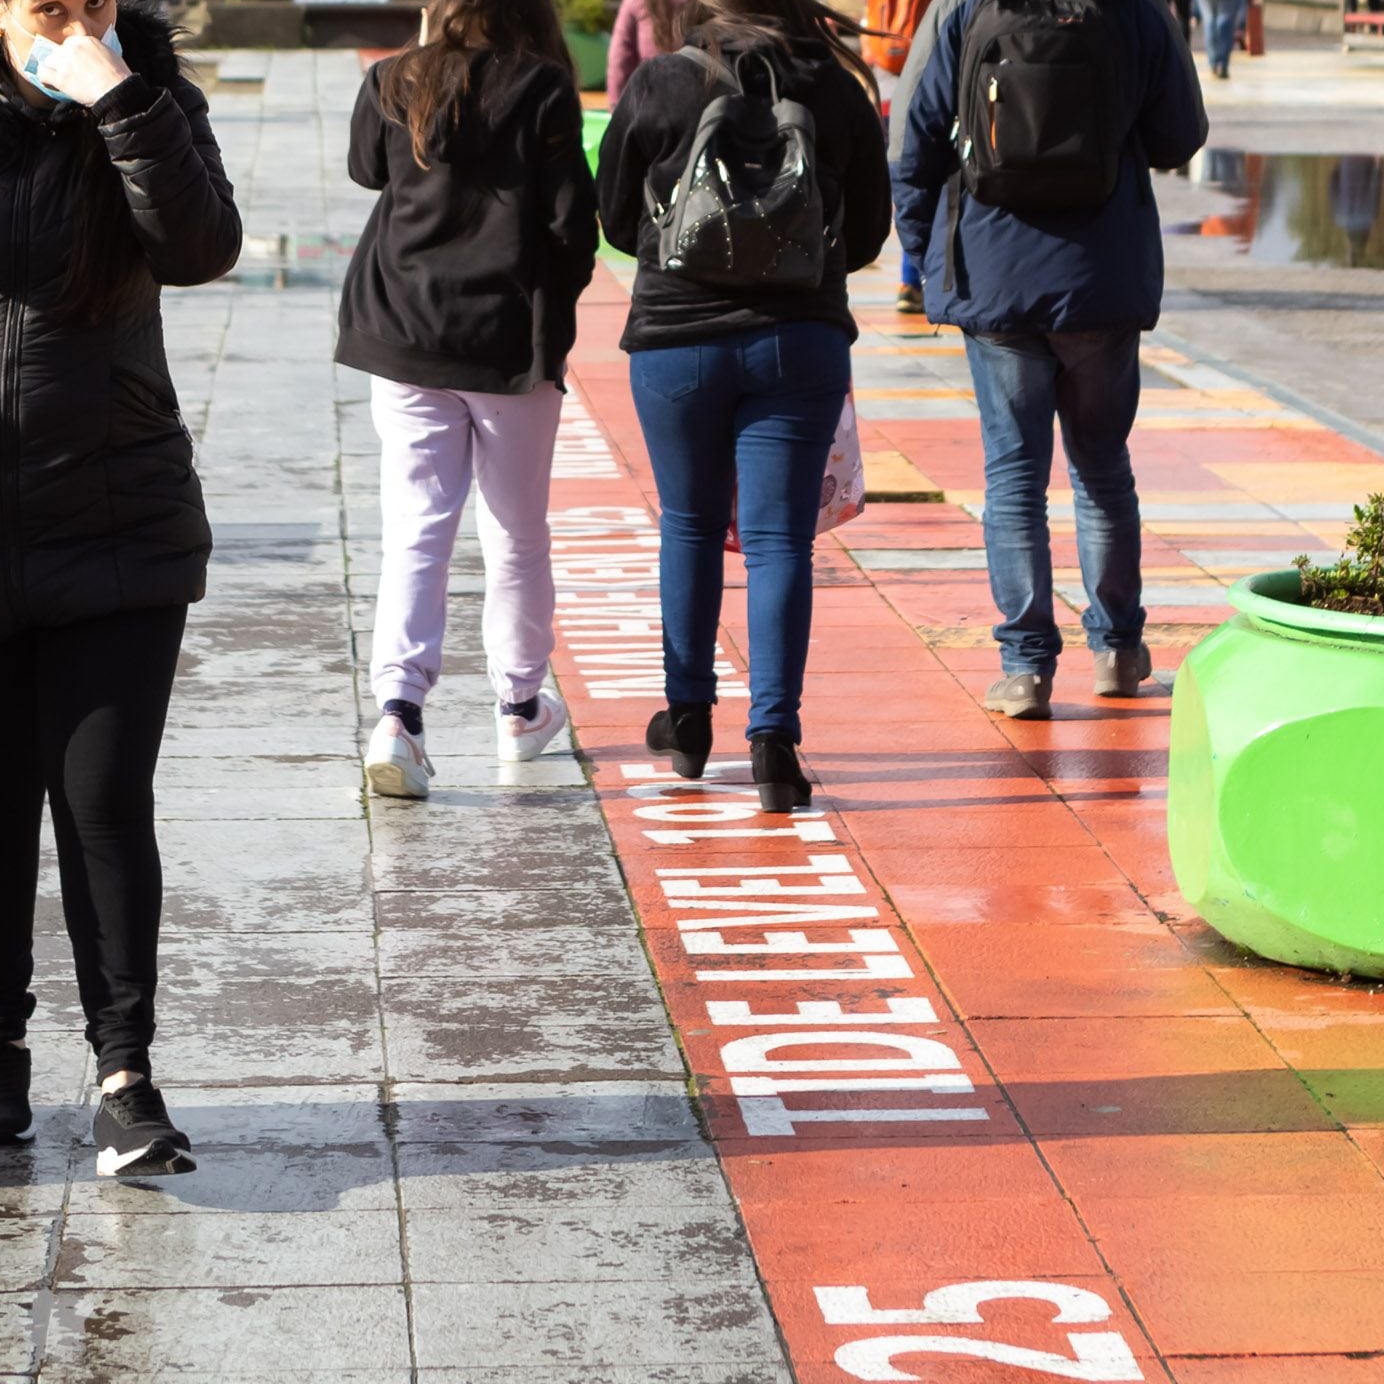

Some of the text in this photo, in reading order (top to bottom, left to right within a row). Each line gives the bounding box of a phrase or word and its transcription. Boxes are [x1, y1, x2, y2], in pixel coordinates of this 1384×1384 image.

[619, 760, 991, 1137] TIDE LEVEL 1925
[813, 1280, 1146, 1384] 25
